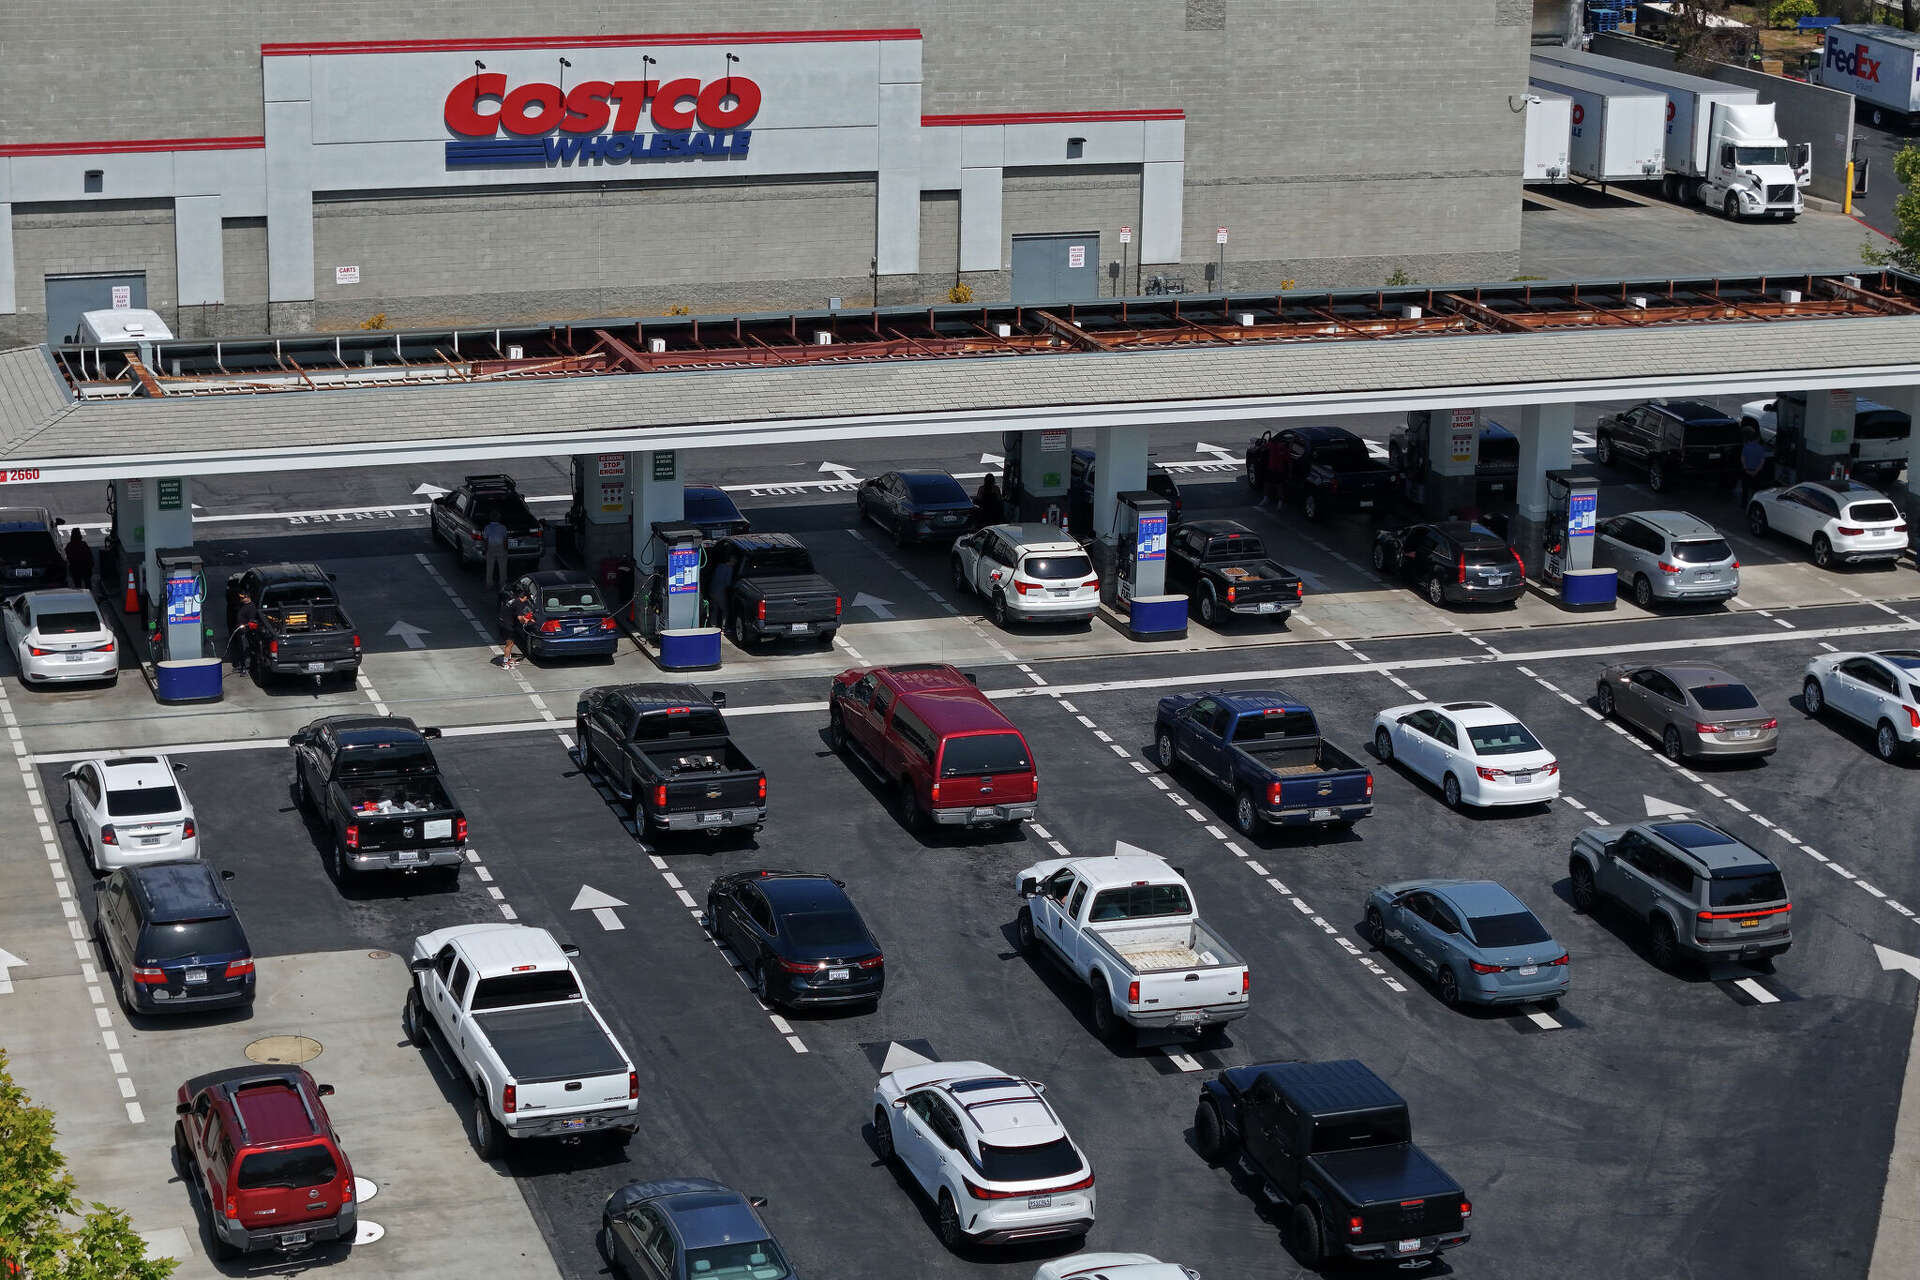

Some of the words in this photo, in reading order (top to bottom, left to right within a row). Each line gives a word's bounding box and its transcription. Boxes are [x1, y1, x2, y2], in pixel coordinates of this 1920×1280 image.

[1826, 36, 1881, 83] FedEx
[444, 72, 761, 136] COSTCO
[543, 131, 752, 161] WHOLESALE
[10, 468, 40, 481] 2660
[288, 510, 397, 524] ENTER
